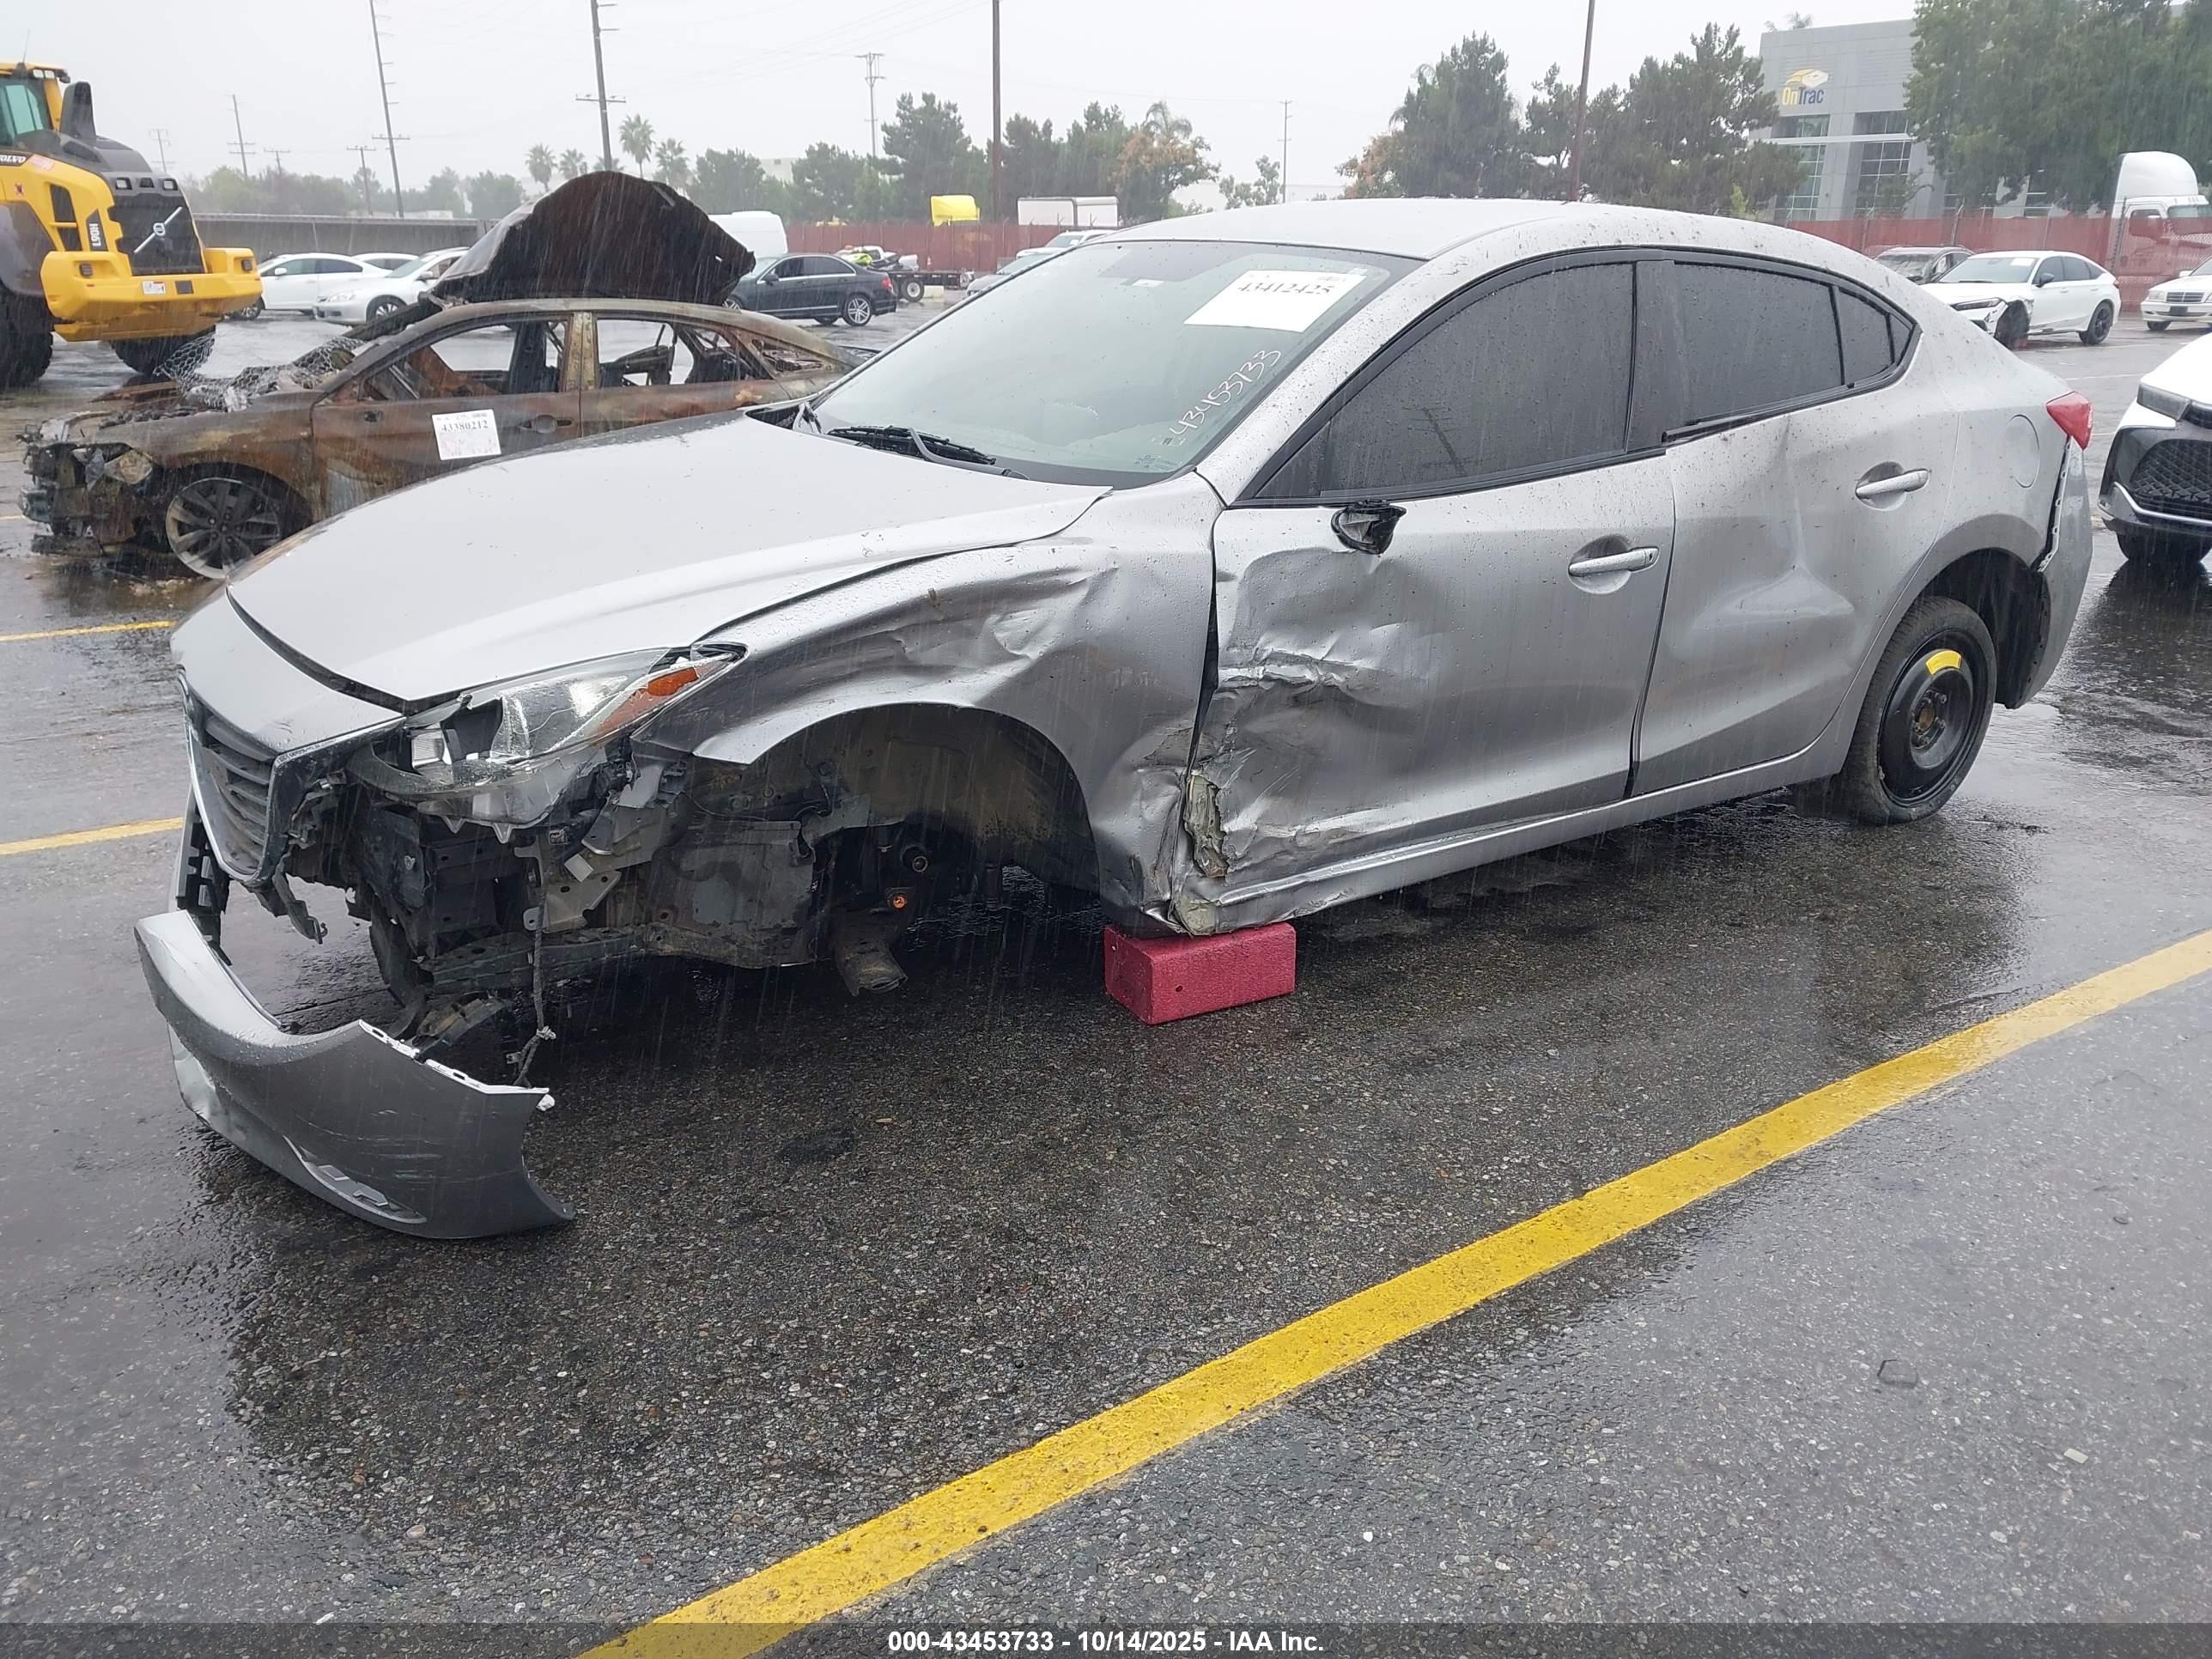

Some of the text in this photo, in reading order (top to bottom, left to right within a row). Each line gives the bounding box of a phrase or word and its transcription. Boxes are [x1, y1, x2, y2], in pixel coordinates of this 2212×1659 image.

[1782, 86, 1825, 106] OnTrac
[0, 155, 27, 163] OLVO
[88, 222, 102, 246] L90H
[1169, 349, 1281, 435] 43453733
[441, 419, 489, 432] 43380212
